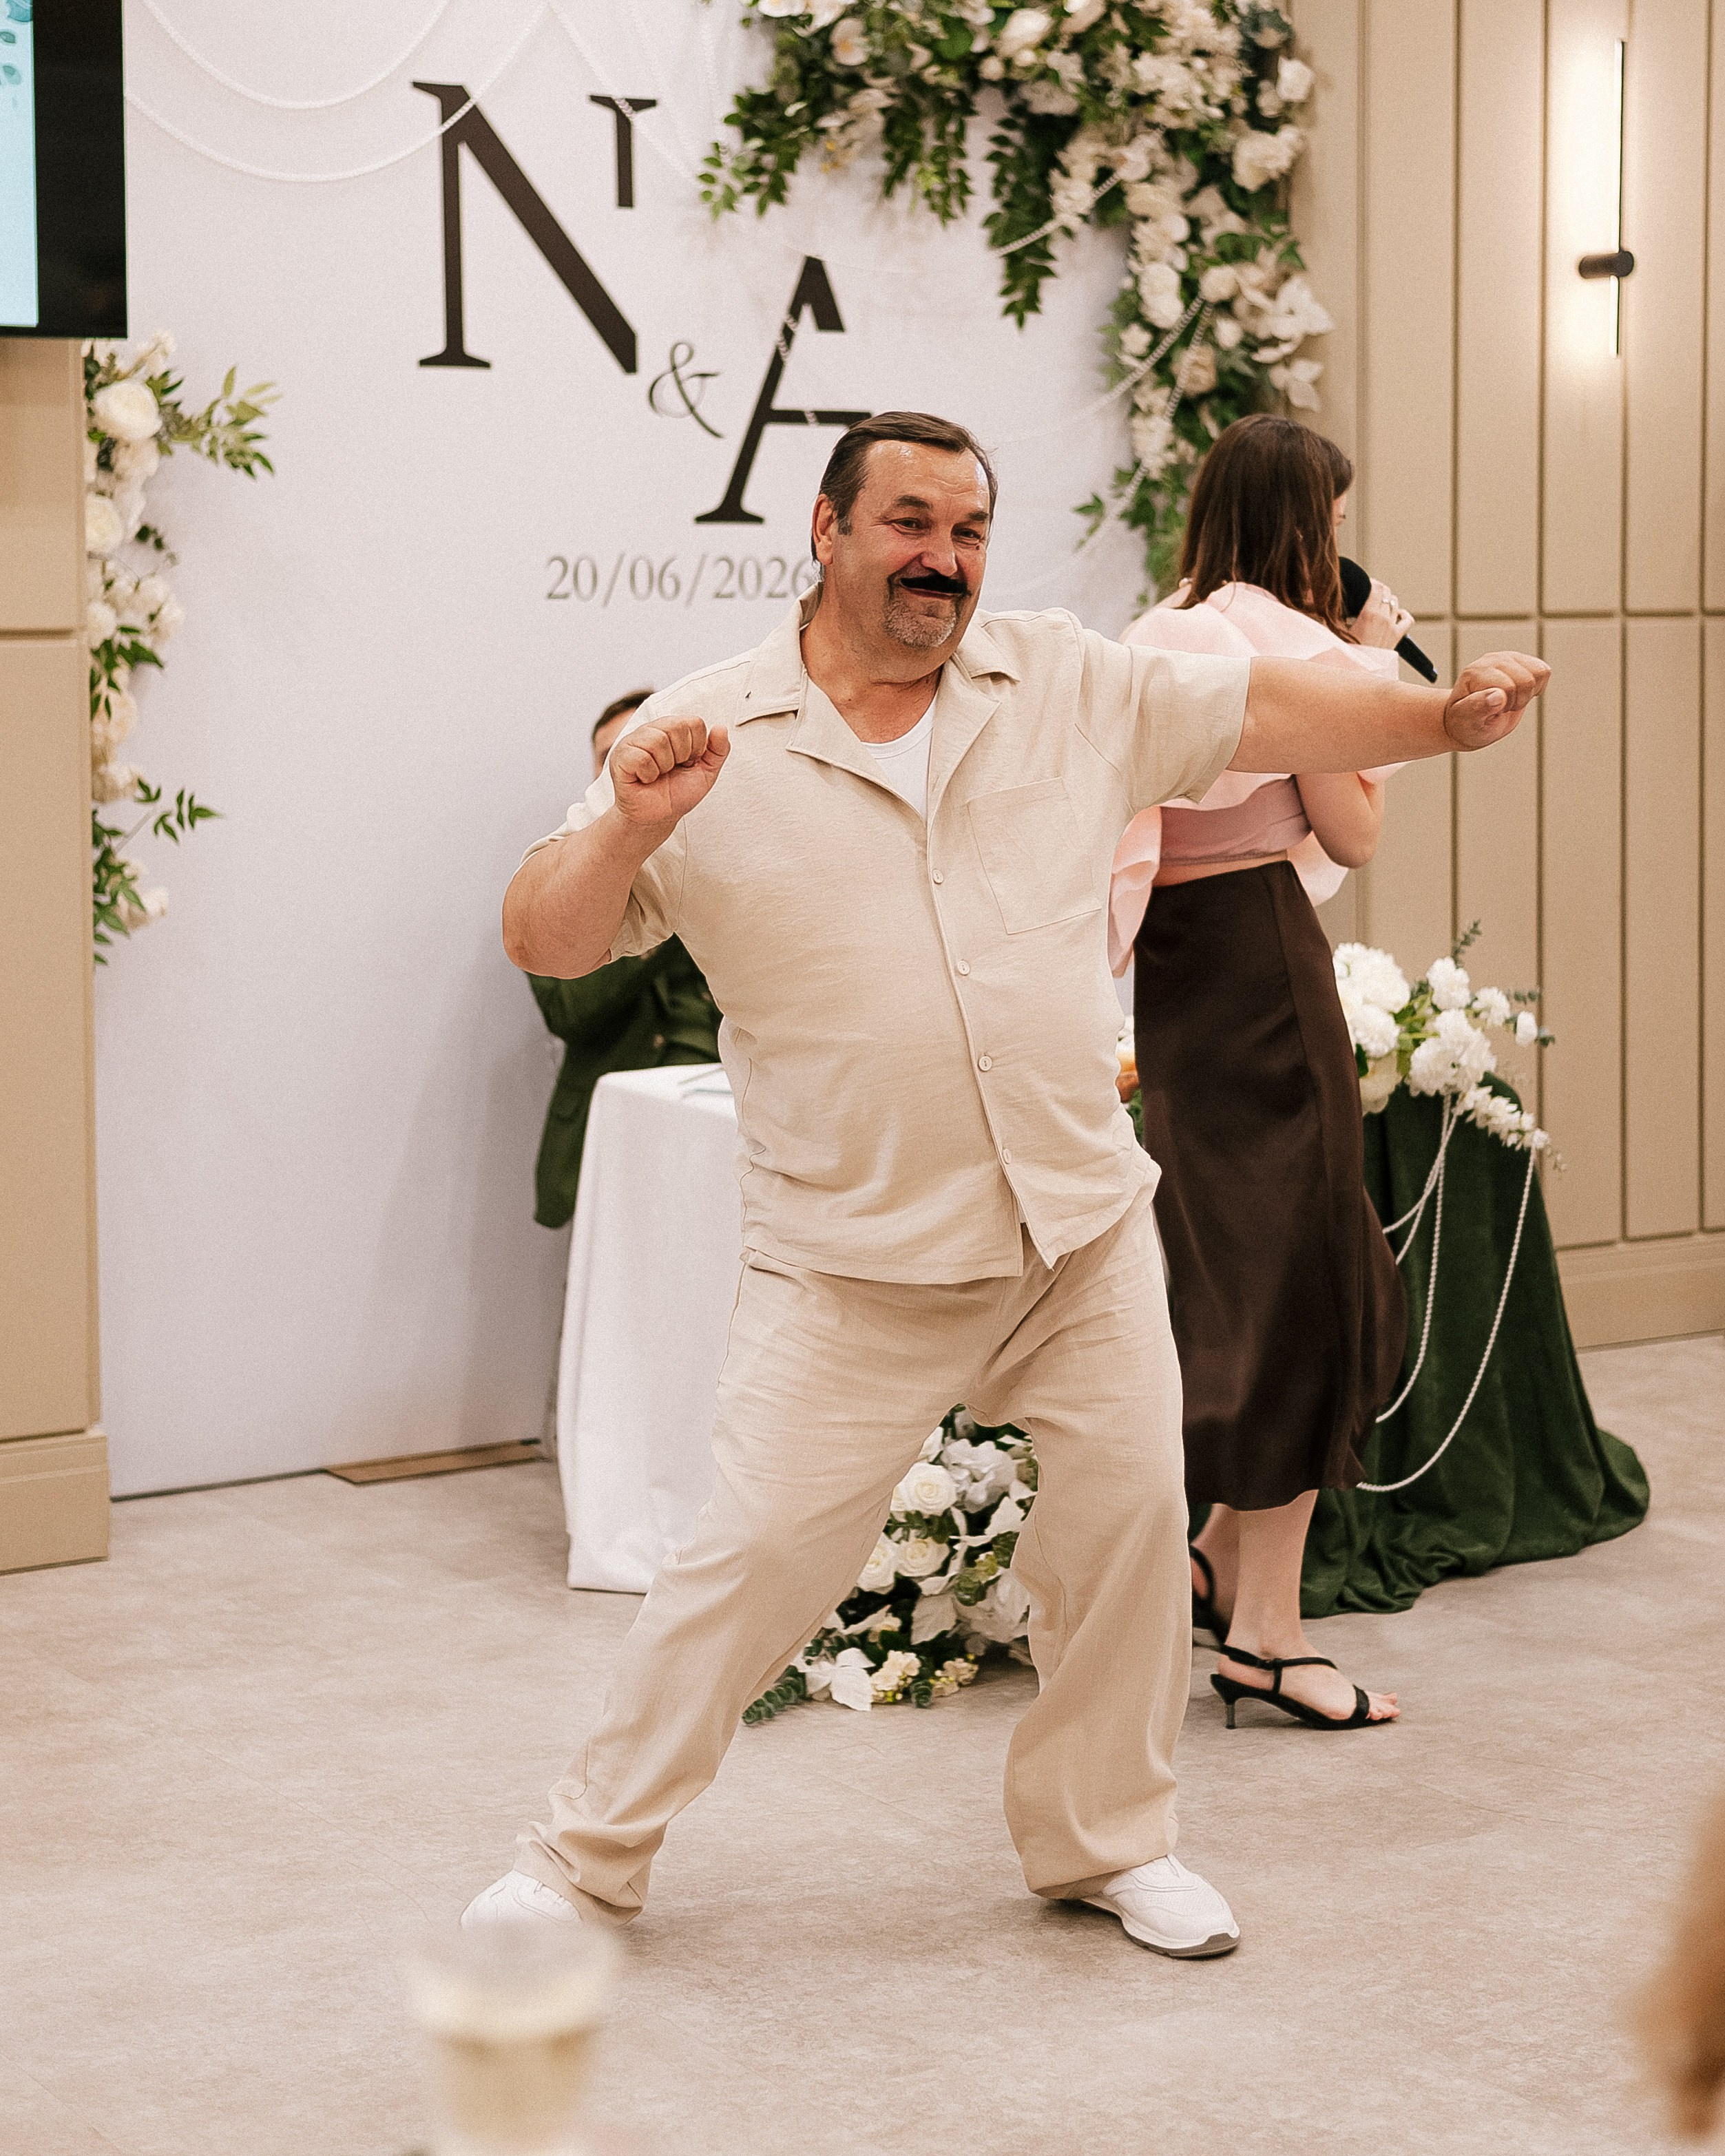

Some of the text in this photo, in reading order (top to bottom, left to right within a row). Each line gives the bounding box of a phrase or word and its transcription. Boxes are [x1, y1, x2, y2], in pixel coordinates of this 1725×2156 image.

[412, 81, 872, 524] N & A
